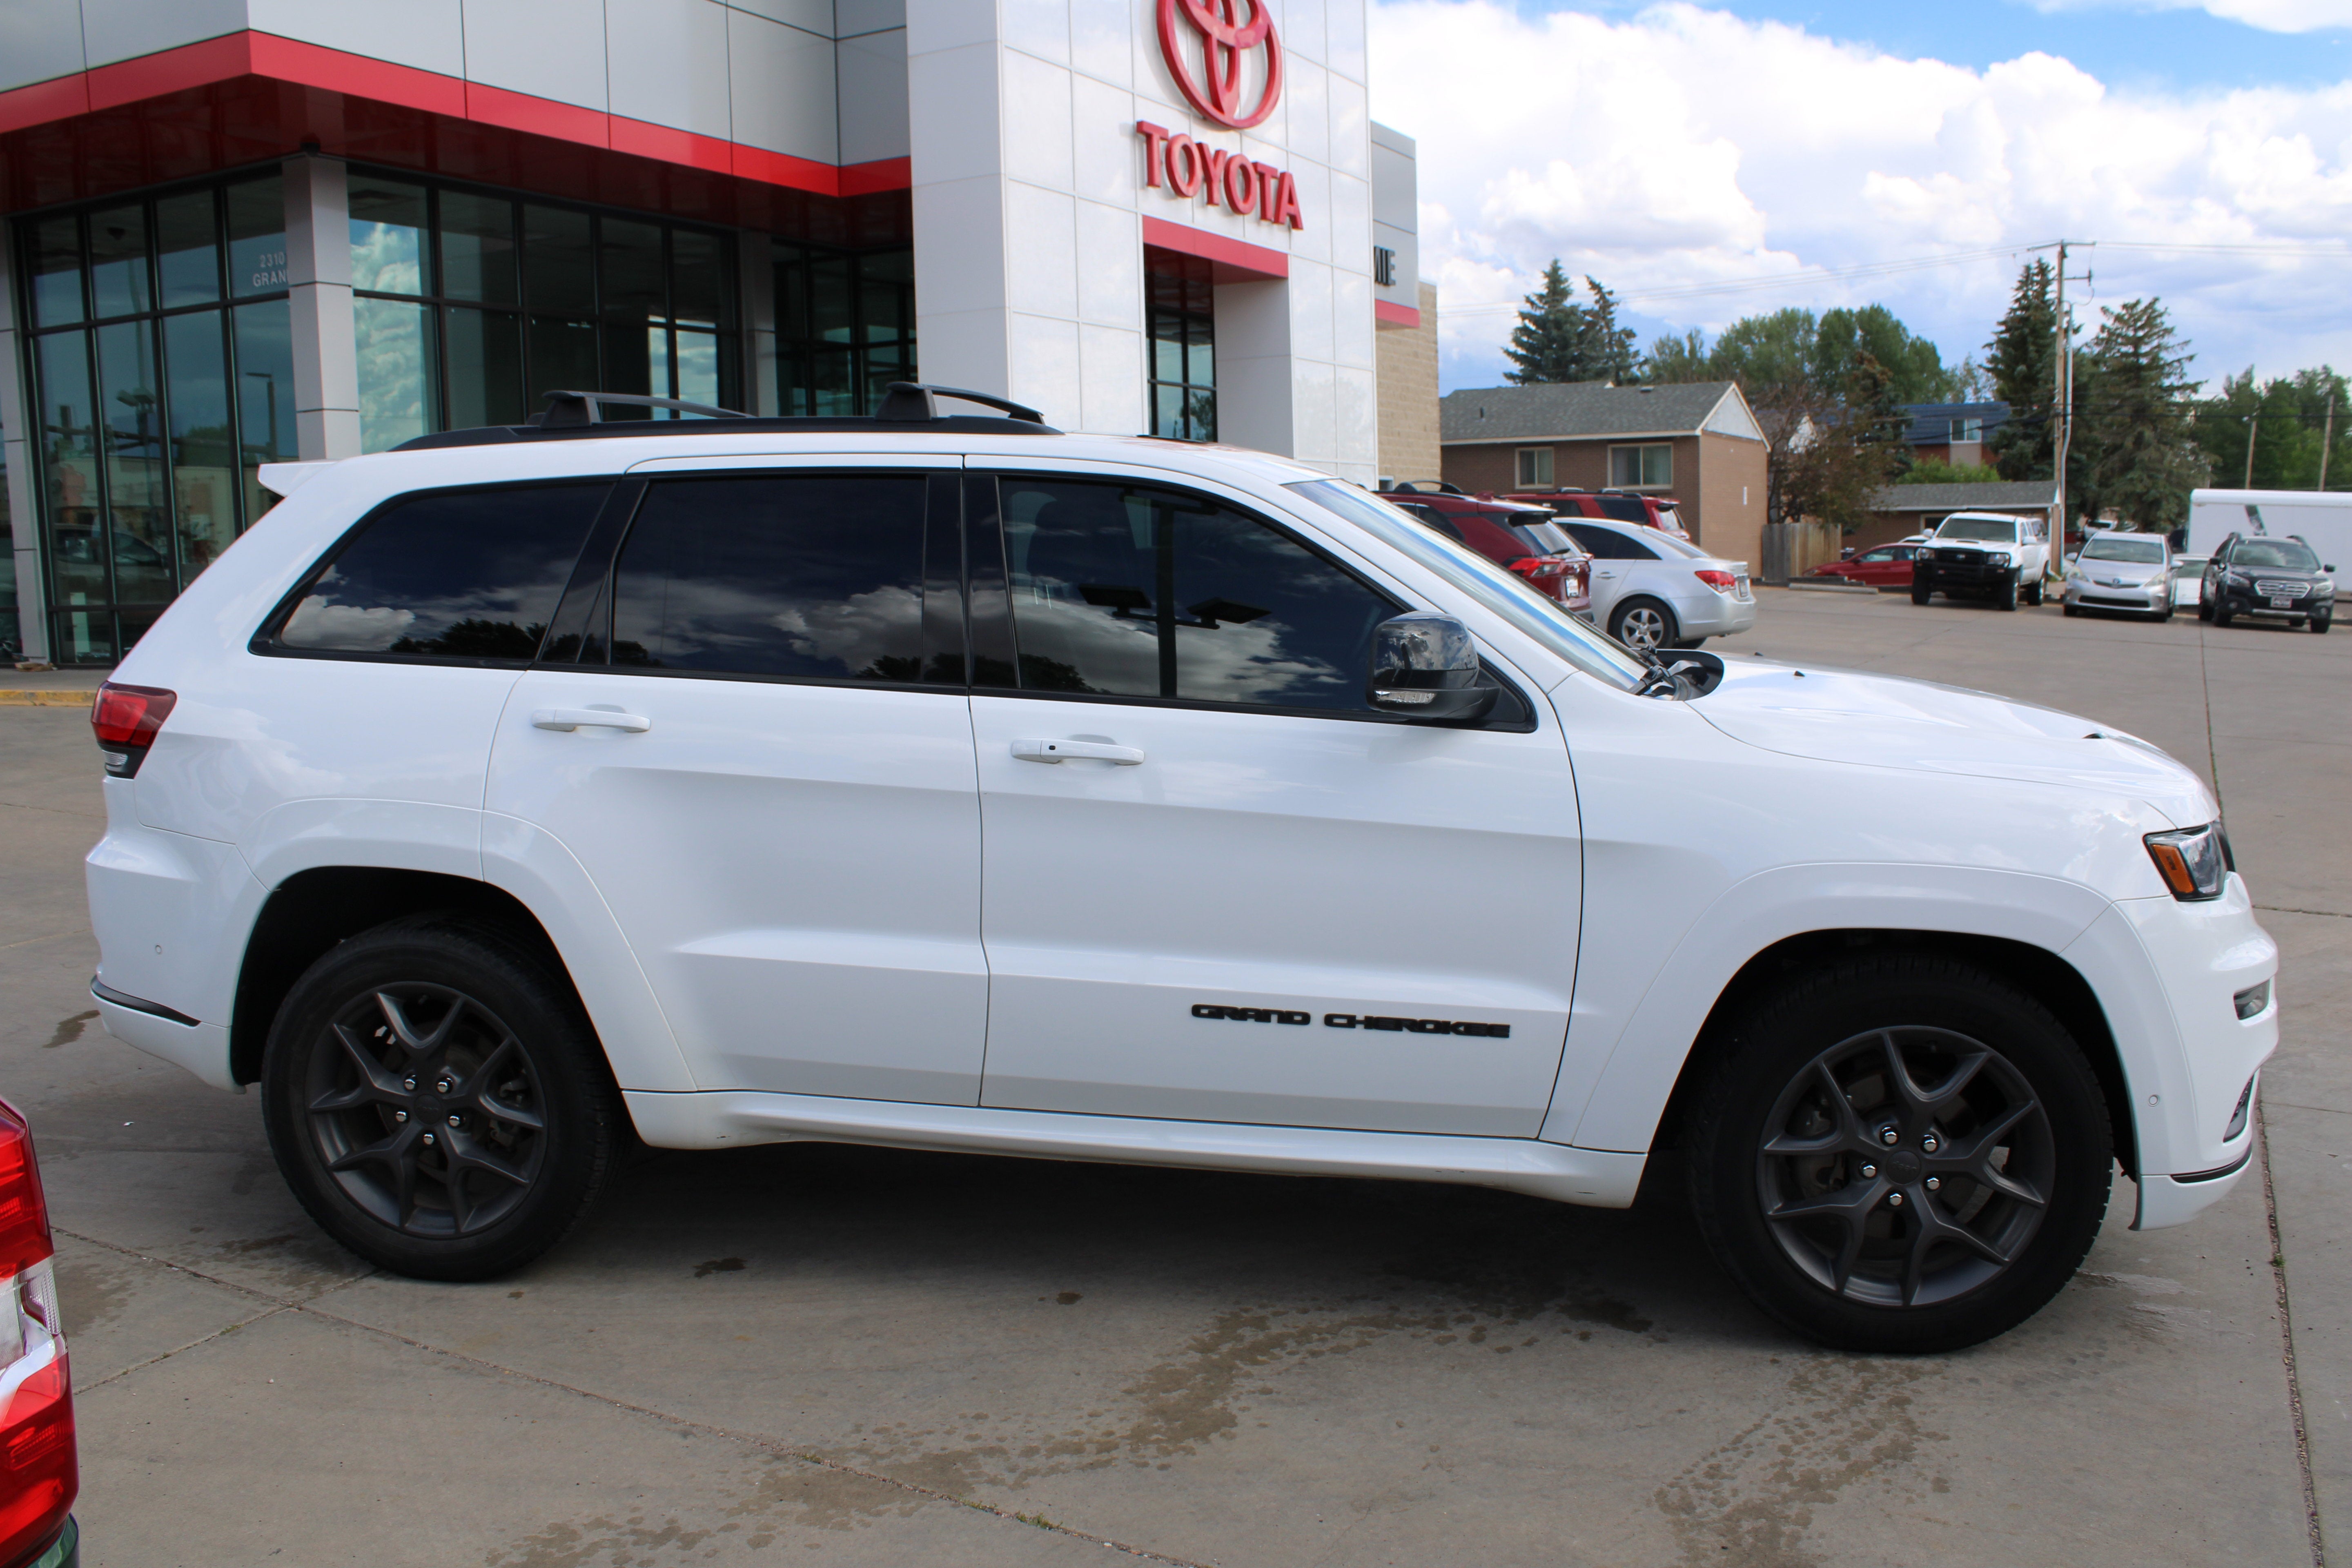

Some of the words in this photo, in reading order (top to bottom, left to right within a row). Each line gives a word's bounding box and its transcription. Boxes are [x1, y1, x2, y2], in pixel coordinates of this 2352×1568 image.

[1137, 120, 1303, 230] TOYOTA
[259, 252, 285, 267] 2310
[1192, 1004, 1311, 1025] GRAND
[1324, 1013, 1510, 1038] CHEROKEE
